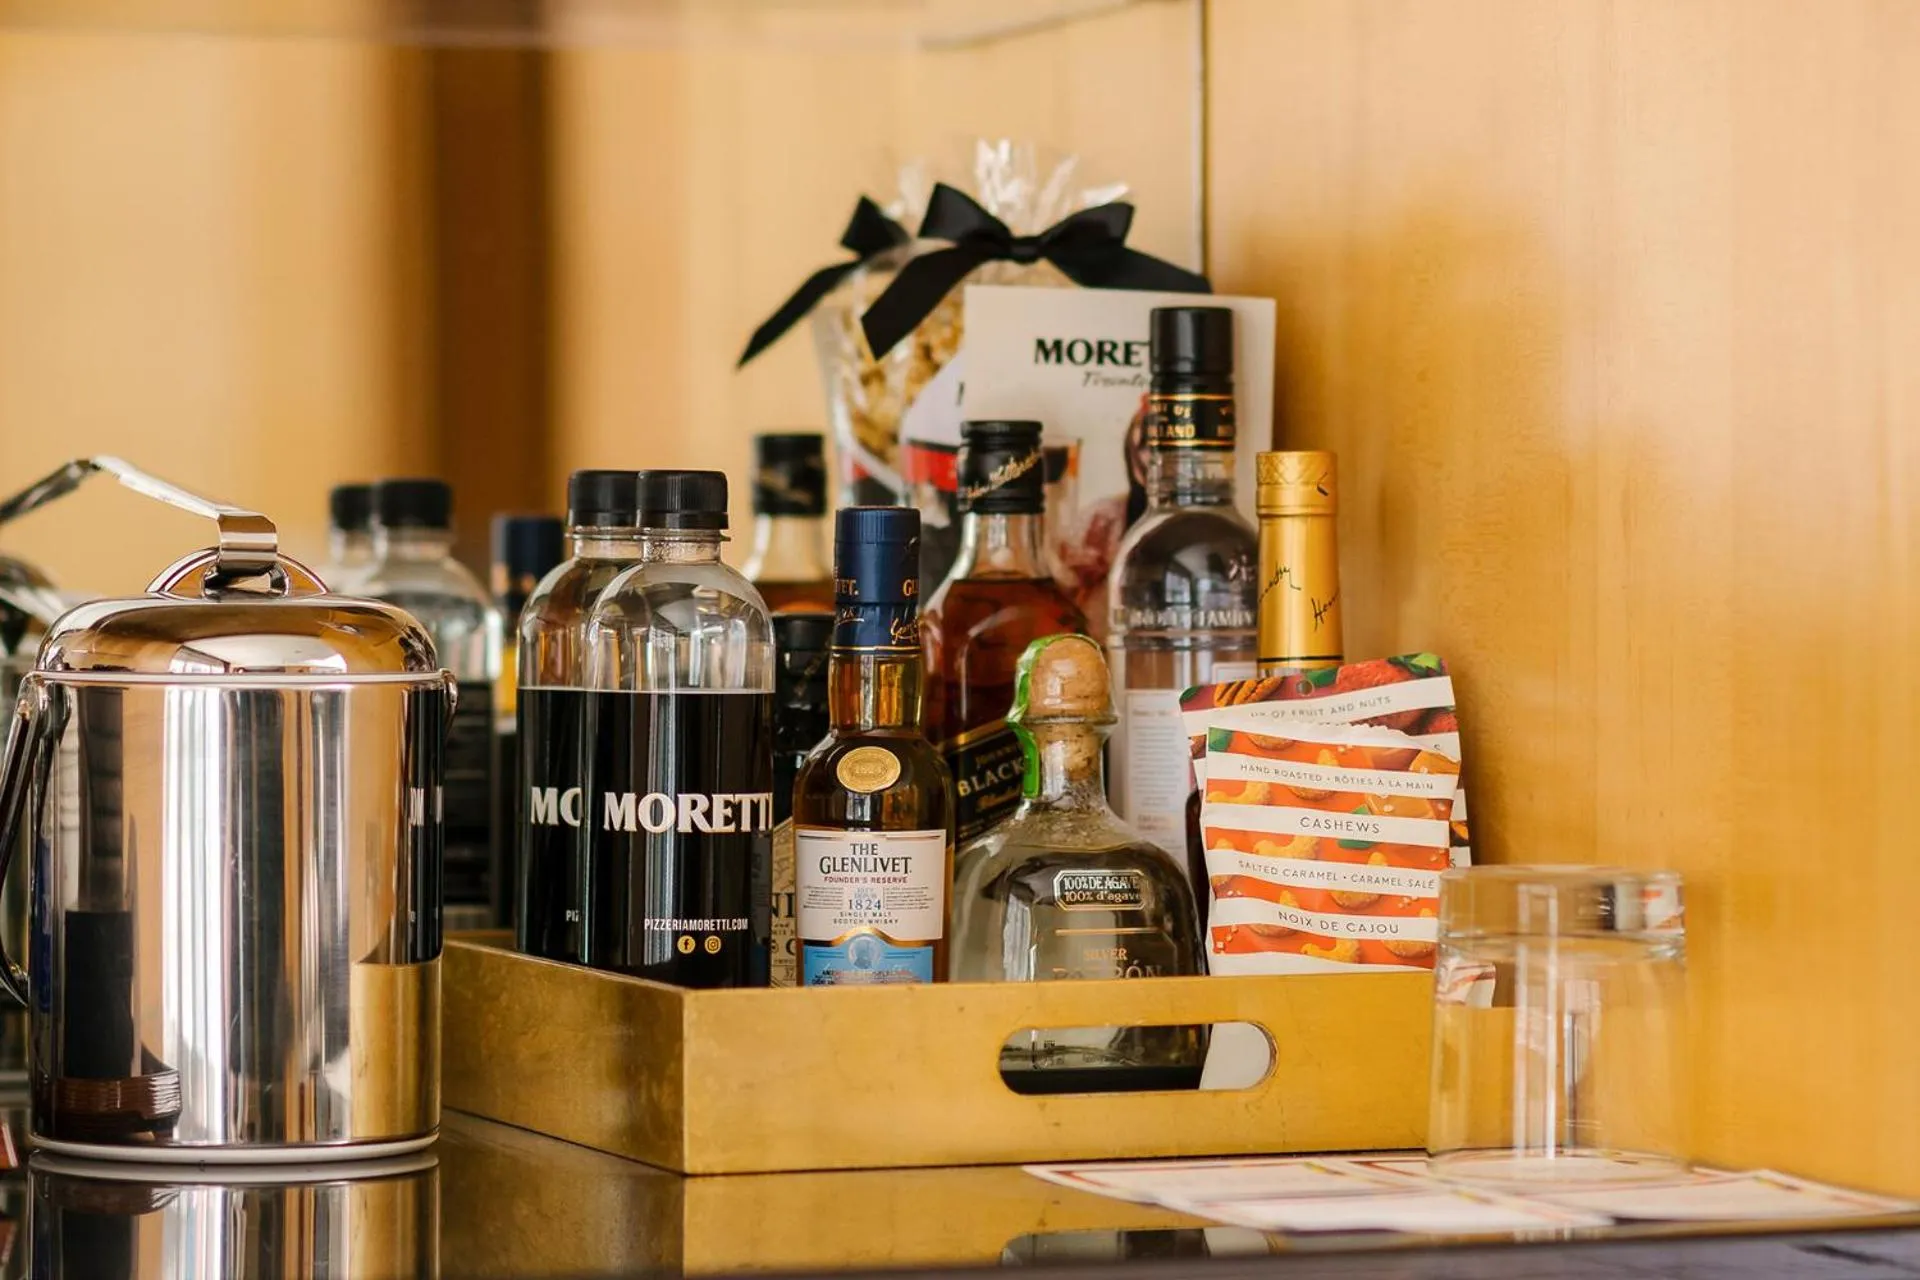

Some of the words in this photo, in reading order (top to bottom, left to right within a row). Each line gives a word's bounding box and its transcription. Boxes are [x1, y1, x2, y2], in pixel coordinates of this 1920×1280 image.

[1292, 708, 1325, 718] FRUIT
[1330, 703, 1354, 715] AND
[1359, 695, 1391, 708] NUTS
[1240, 763, 1270, 774] HAND
[1274, 768, 1322, 782] ROASTED
[1334, 776, 1373, 786] RÔTIES
[1406, 782, 1434, 790] MAIN
[1299, 816, 1381, 834] CASHEWS
[850, 843, 879, 856] THE
[871, 876, 909, 884] RESERVE
[1238, 859, 1278, 876] SALTED
[1282, 867, 1338, 882] CARAMEL
[1350, 873, 1403, 887] CARAMEL
[1408, 878, 1436, 889] SALÉ
[1064, 890, 1094, 902] 100%
[848, 899, 882, 911] 1824
[643, 918, 749, 931] PIZZERIAMORETTI.COM
[1278, 910, 1312, 927] NOIX
[1319, 920, 1339, 932] DE
[1346, 923, 1399, 934] CAJOU
